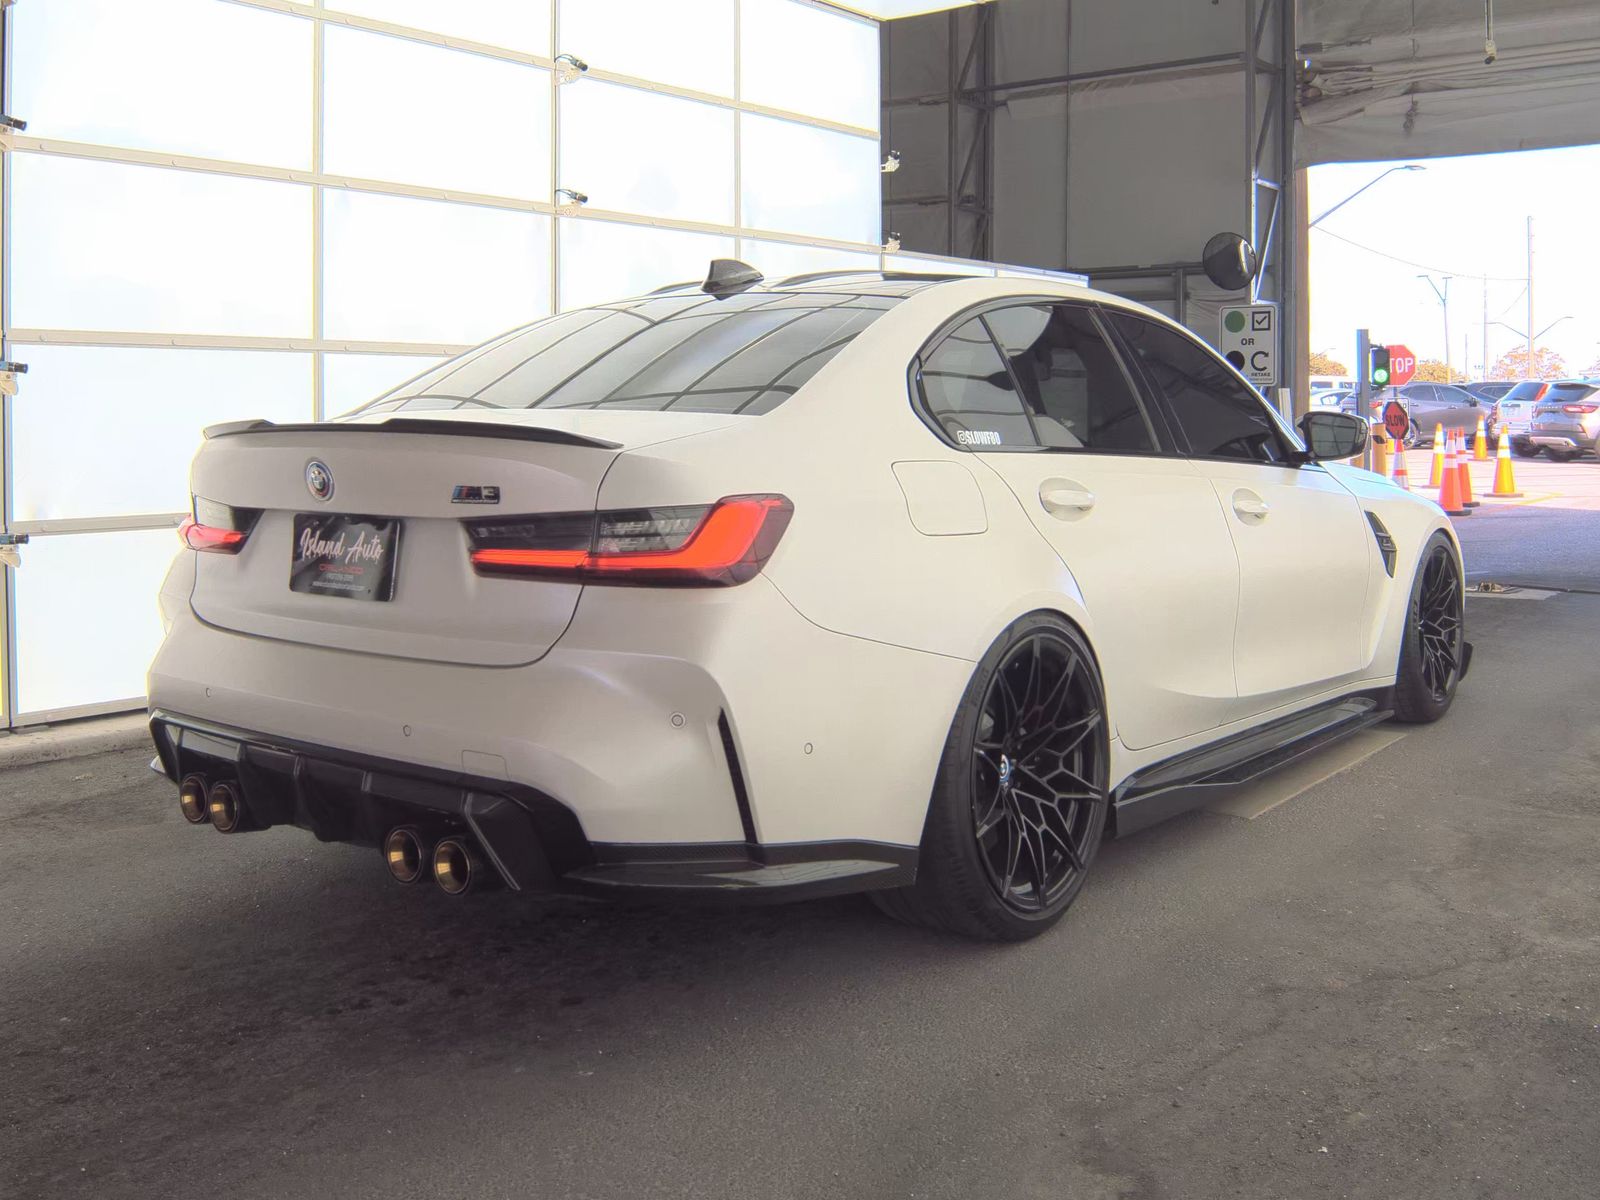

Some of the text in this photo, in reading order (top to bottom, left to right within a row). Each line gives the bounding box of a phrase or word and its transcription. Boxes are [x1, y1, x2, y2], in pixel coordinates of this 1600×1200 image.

[1240, 338, 1255, 346] OR
[1389, 357, 1414, 374] TOP
[1385, 414, 1406, 427] SLOW
[300, 528, 384, 564] Island Auto
